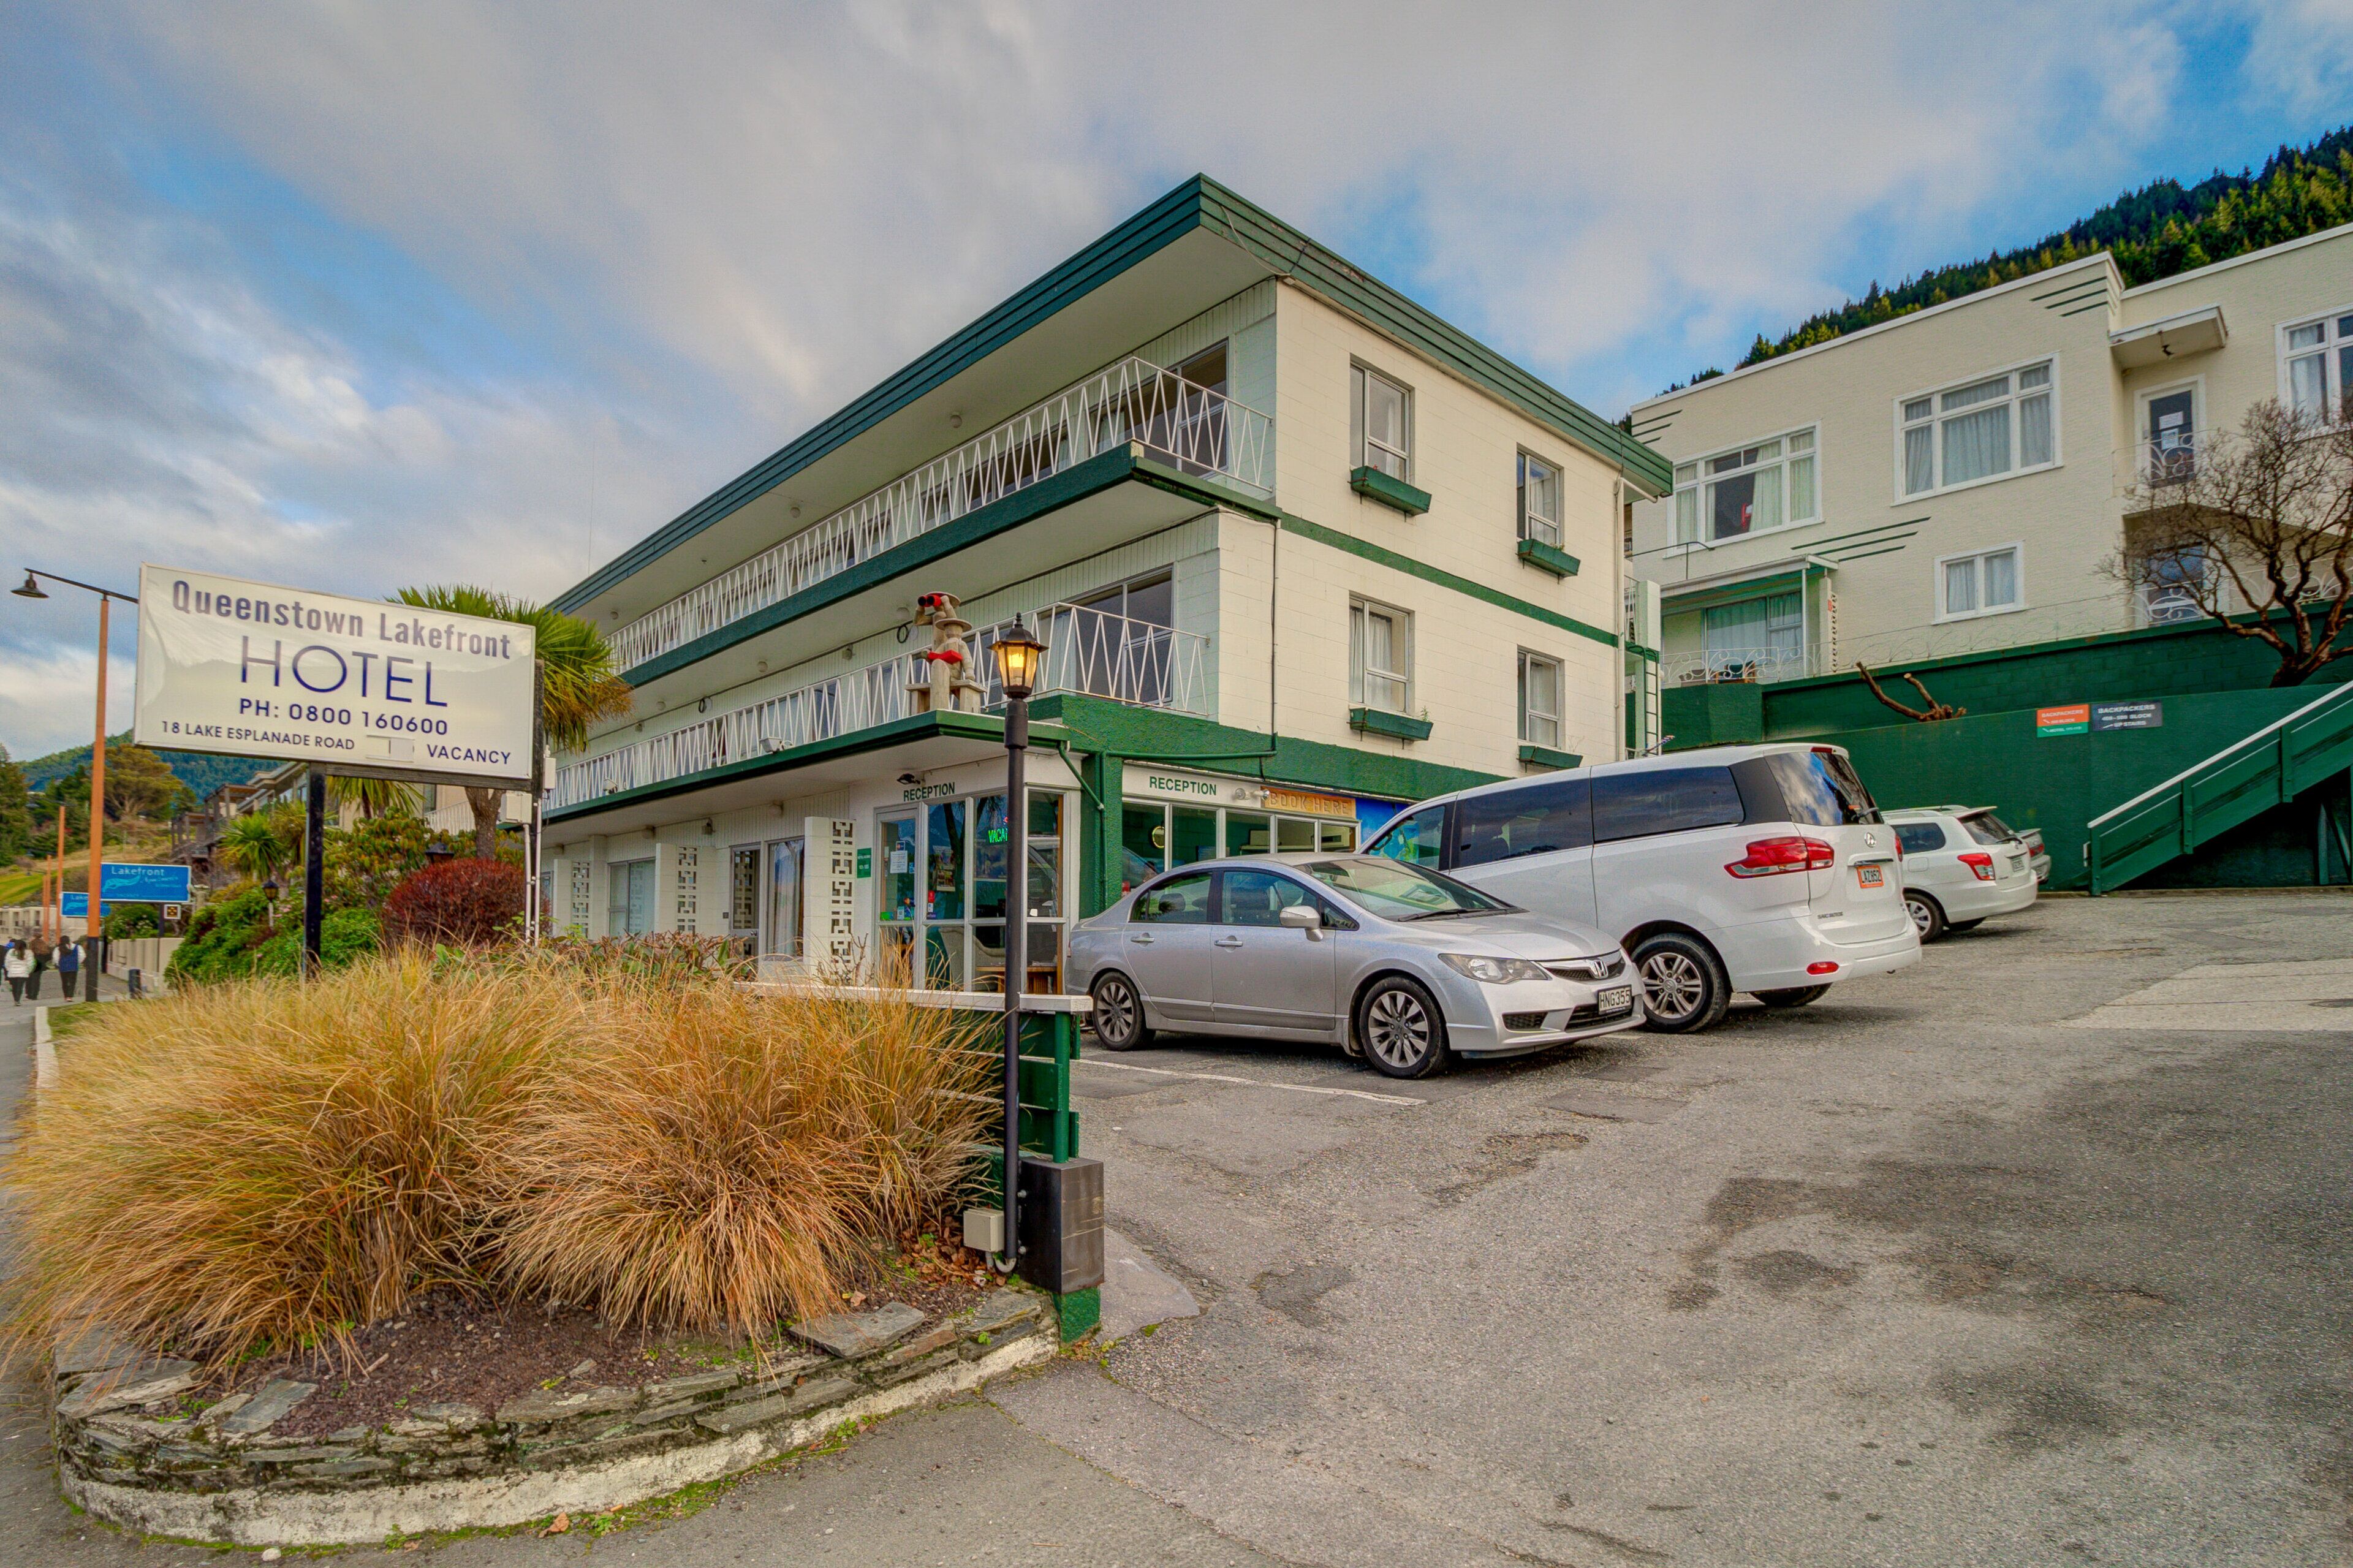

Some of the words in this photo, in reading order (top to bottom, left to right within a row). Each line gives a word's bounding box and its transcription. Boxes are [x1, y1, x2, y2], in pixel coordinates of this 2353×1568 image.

[173, 580, 364, 637] Queenstown
[381, 613, 511, 660] Lakefront
[241, 635, 448, 707] HOTEL
[240, 697, 279, 718] PH:
[289, 703, 351, 725] 0800
[362, 711, 448, 735] 160600
[2097, 705, 2156, 714] BACKPACKERS
[162, 720, 180, 734] 18
[186, 722, 222, 738] LAKE
[227, 727, 311, 746] ESPLANADE
[315, 735, 355, 751] ROAD
[427, 743, 511, 765] VACANCY
[903, 781, 955, 802] RECEPTION
[1150, 776, 1217, 796] RECEPTION
[1270, 792, 1307, 811] BOOK
[1313, 797, 1349, 815] HERE
[112, 866, 165, 876] Lakefront
[1599, 990, 1630, 1009] HNG355
